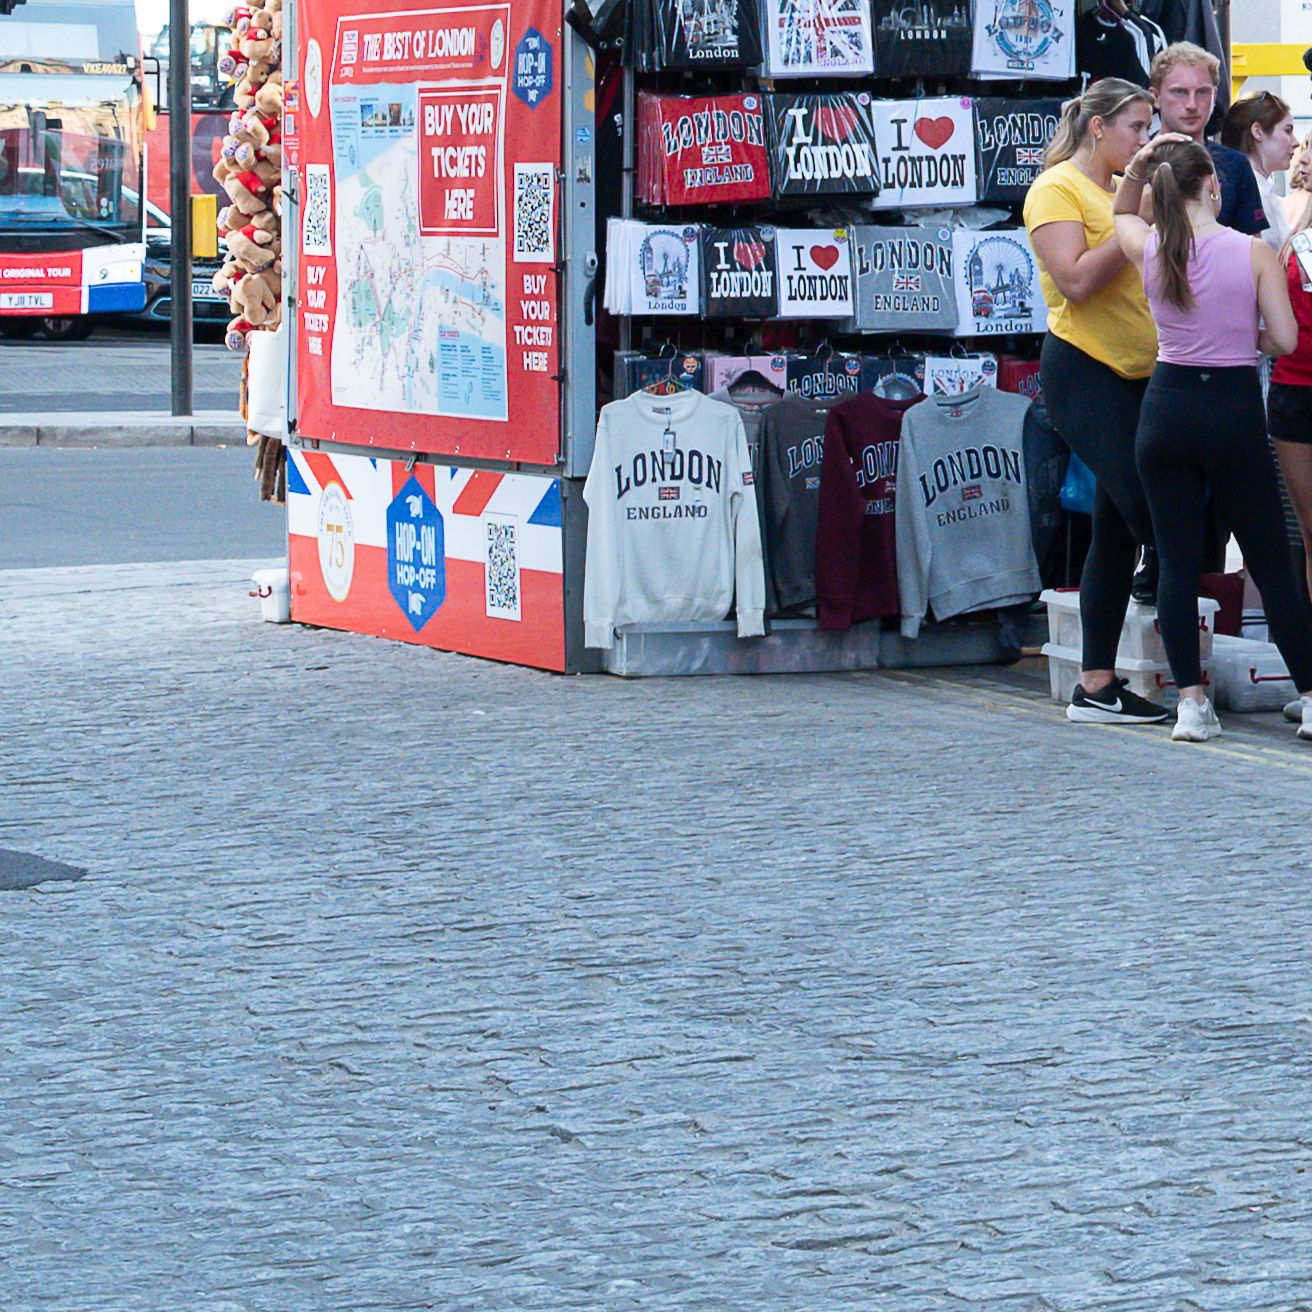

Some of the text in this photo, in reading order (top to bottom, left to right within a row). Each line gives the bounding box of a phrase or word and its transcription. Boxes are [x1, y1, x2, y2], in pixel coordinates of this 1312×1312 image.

[362, 33, 383, 62] THE
[382, 31, 412, 61] BEST
[412, 29, 427, 59] OF
[427, 26, 476, 58] LONDON
[901, 30, 947, 40] LONDON
[517, 52, 546, 75] HOP-ON
[688, 47, 739, 59] London
[517, 74, 546, 88] HOP-OFF
[424, 104, 457, 136] BUY
[456, 103, 494, 135] YOUR
[662, 110, 765, 156] LONDON
[788, 107, 812, 144] I
[979, 113, 1061, 152] LONDO
[890, 118, 910, 152] I
[431, 145, 487, 178] TICKETS
[683, 163, 754, 188] ENGLAND
[786, 143, 872, 180] LONDON
[882, 153, 966, 189] LONDON
[444, 189, 475, 220] HERE
[714, 241, 731, 270] I
[792, 245, 807, 271] I
[857, 239, 953, 277] LONDON
[3, 267, 72, 279] ORIGINAL TOUR
[523, 275, 547, 295] BUY
[710, 270, 773, 298] LONDON
[28, 295, 45, 306] TVL
[787, 274, 849, 301] LONDON
[520, 300, 551, 321] YOUR
[648, 299, 687, 312] London
[874, 294, 940, 313] ENGLAND
[975, 319, 1033, 333] London
[523, 351, 548, 372] HERE
[790, 371, 859, 400] LONDON
[615, 448, 722, 500] LONDON
[918, 443, 1022, 508] LONDON
[626, 505, 708, 520] ENGLAND
[937, 498, 1011, 528] ENGLAND
[395, 521, 436, 566] HOP-ON
[396, 563, 436, 590] HOP-OFF
